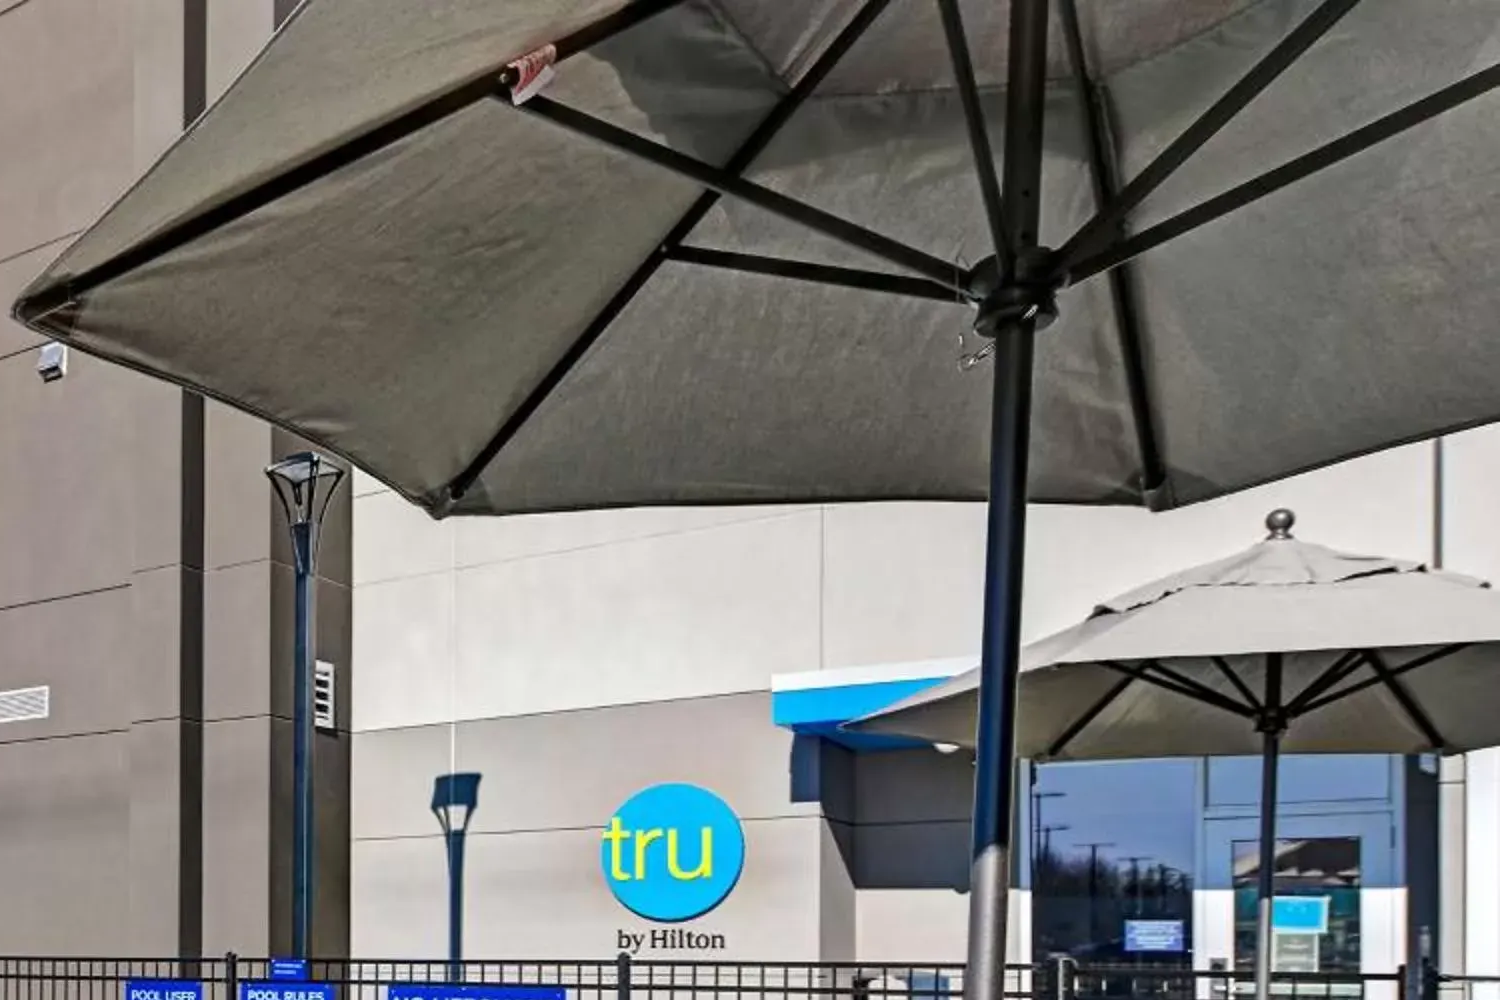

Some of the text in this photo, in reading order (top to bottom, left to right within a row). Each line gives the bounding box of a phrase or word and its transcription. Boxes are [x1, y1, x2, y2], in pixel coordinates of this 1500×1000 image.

[602, 816, 713, 881] tru
[617, 929, 725, 954] by Hilton
